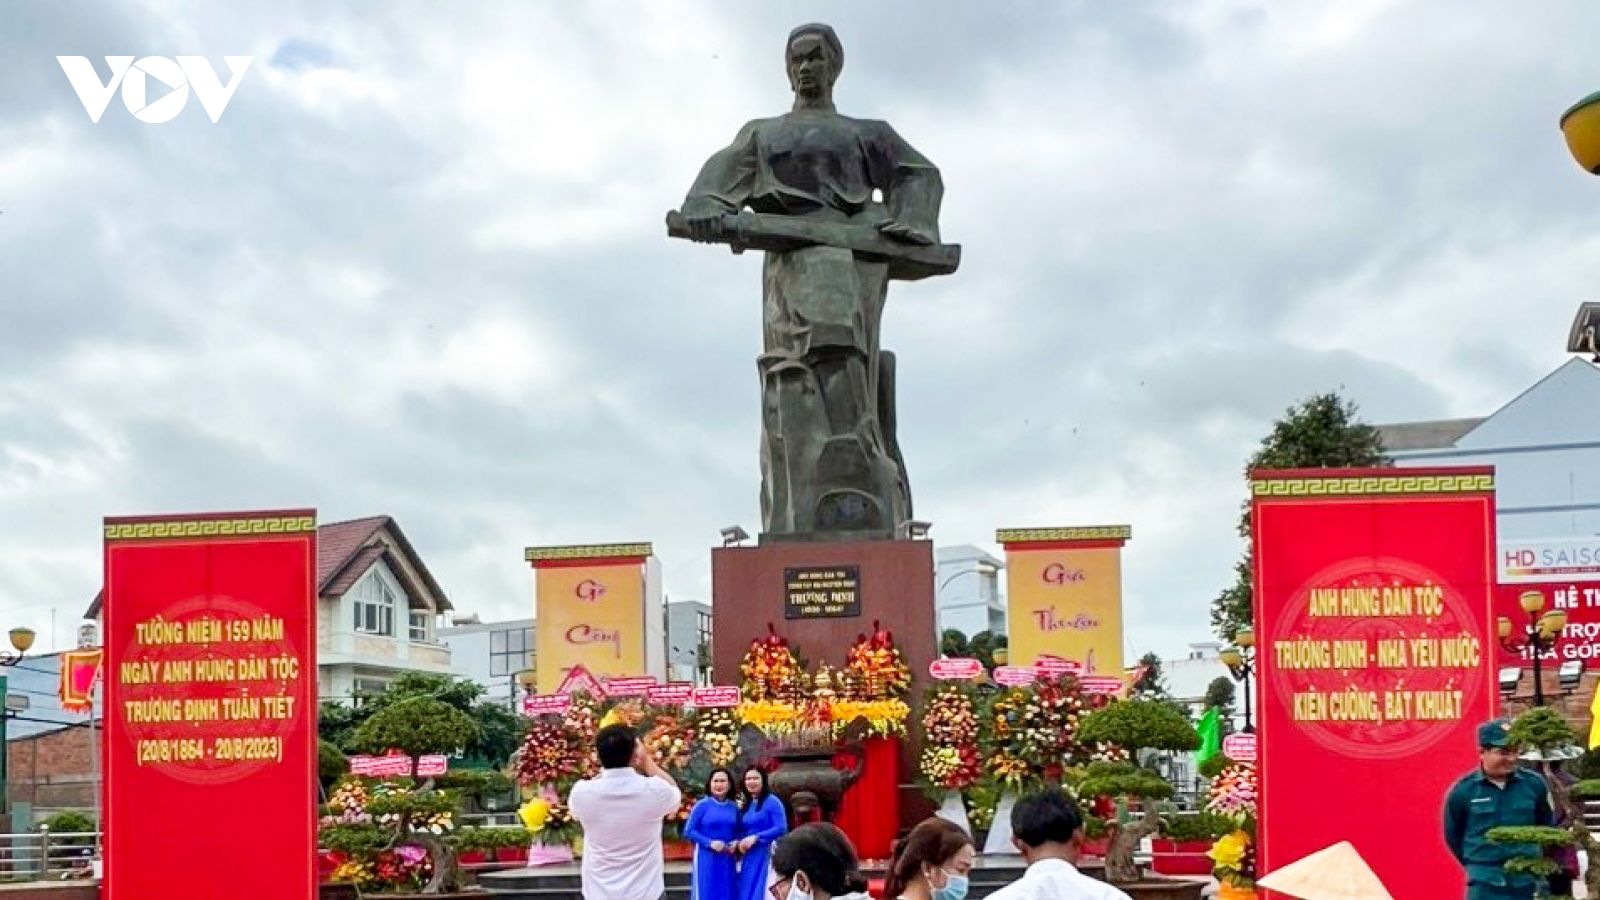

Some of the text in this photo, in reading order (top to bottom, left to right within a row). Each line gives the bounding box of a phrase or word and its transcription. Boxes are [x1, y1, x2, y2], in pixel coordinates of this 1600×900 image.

[1505, 550, 1535, 567] HD
[1309, 579, 1444, 624] ANH HÙNG DÂN TỘC
[136, 614, 284, 649] TƯỞNG NIỆM 159 NĂM
[121, 653, 298, 685] NGÀY ANH HÙNG DÂN TỘC
[1274, 630, 1480, 677] TRƯƠNG ĐỊNH - NHÀ YÊU NƯỚC
[125, 687, 295, 727] TRƯƠNG ĐỊNH TUẪN TIẾT
[1294, 678, 1463, 726] KIÊN CƯỜNG, BẤT KHUẤT
[137, 739, 204, 766] (20/8/1864
[215, 736, 283, 763] 20/8/2023)
